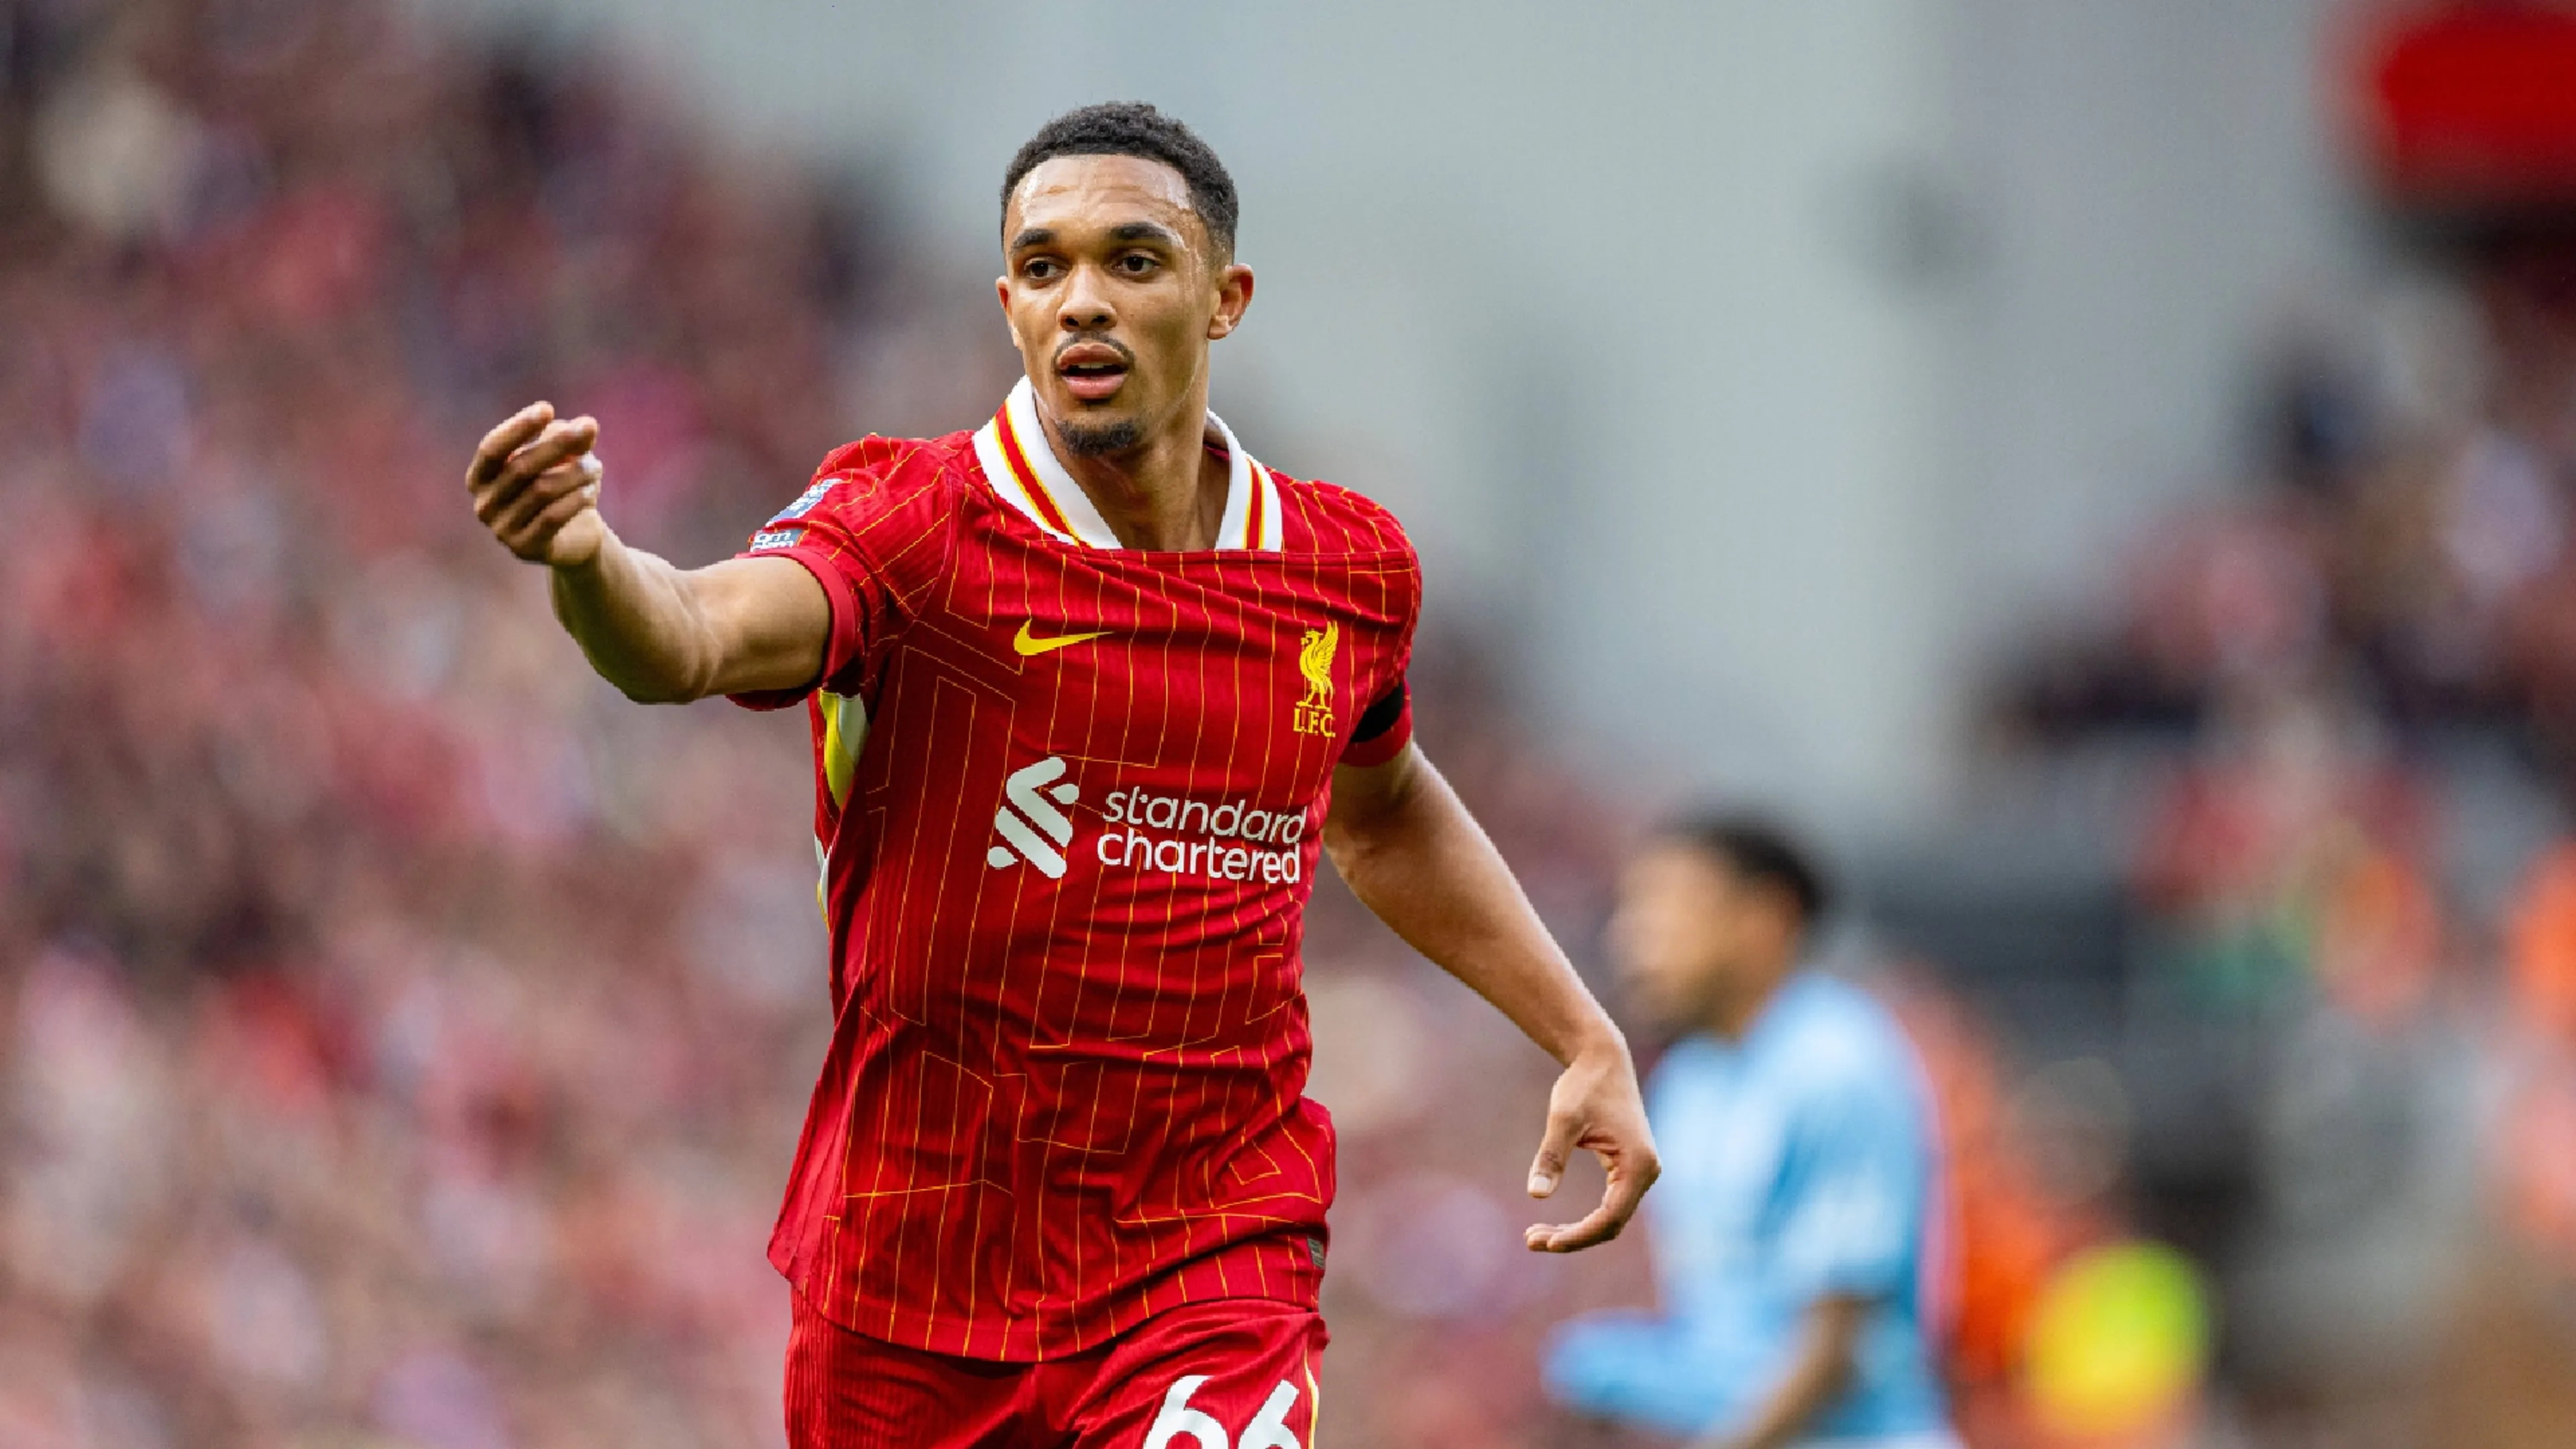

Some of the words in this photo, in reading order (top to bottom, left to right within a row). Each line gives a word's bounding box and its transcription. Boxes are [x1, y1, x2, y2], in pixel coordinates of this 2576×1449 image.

[1102, 786, 1307, 845] standard
[1097, 827, 1301, 884] chartered
[1143, 1375, 1301, 1449] 66
